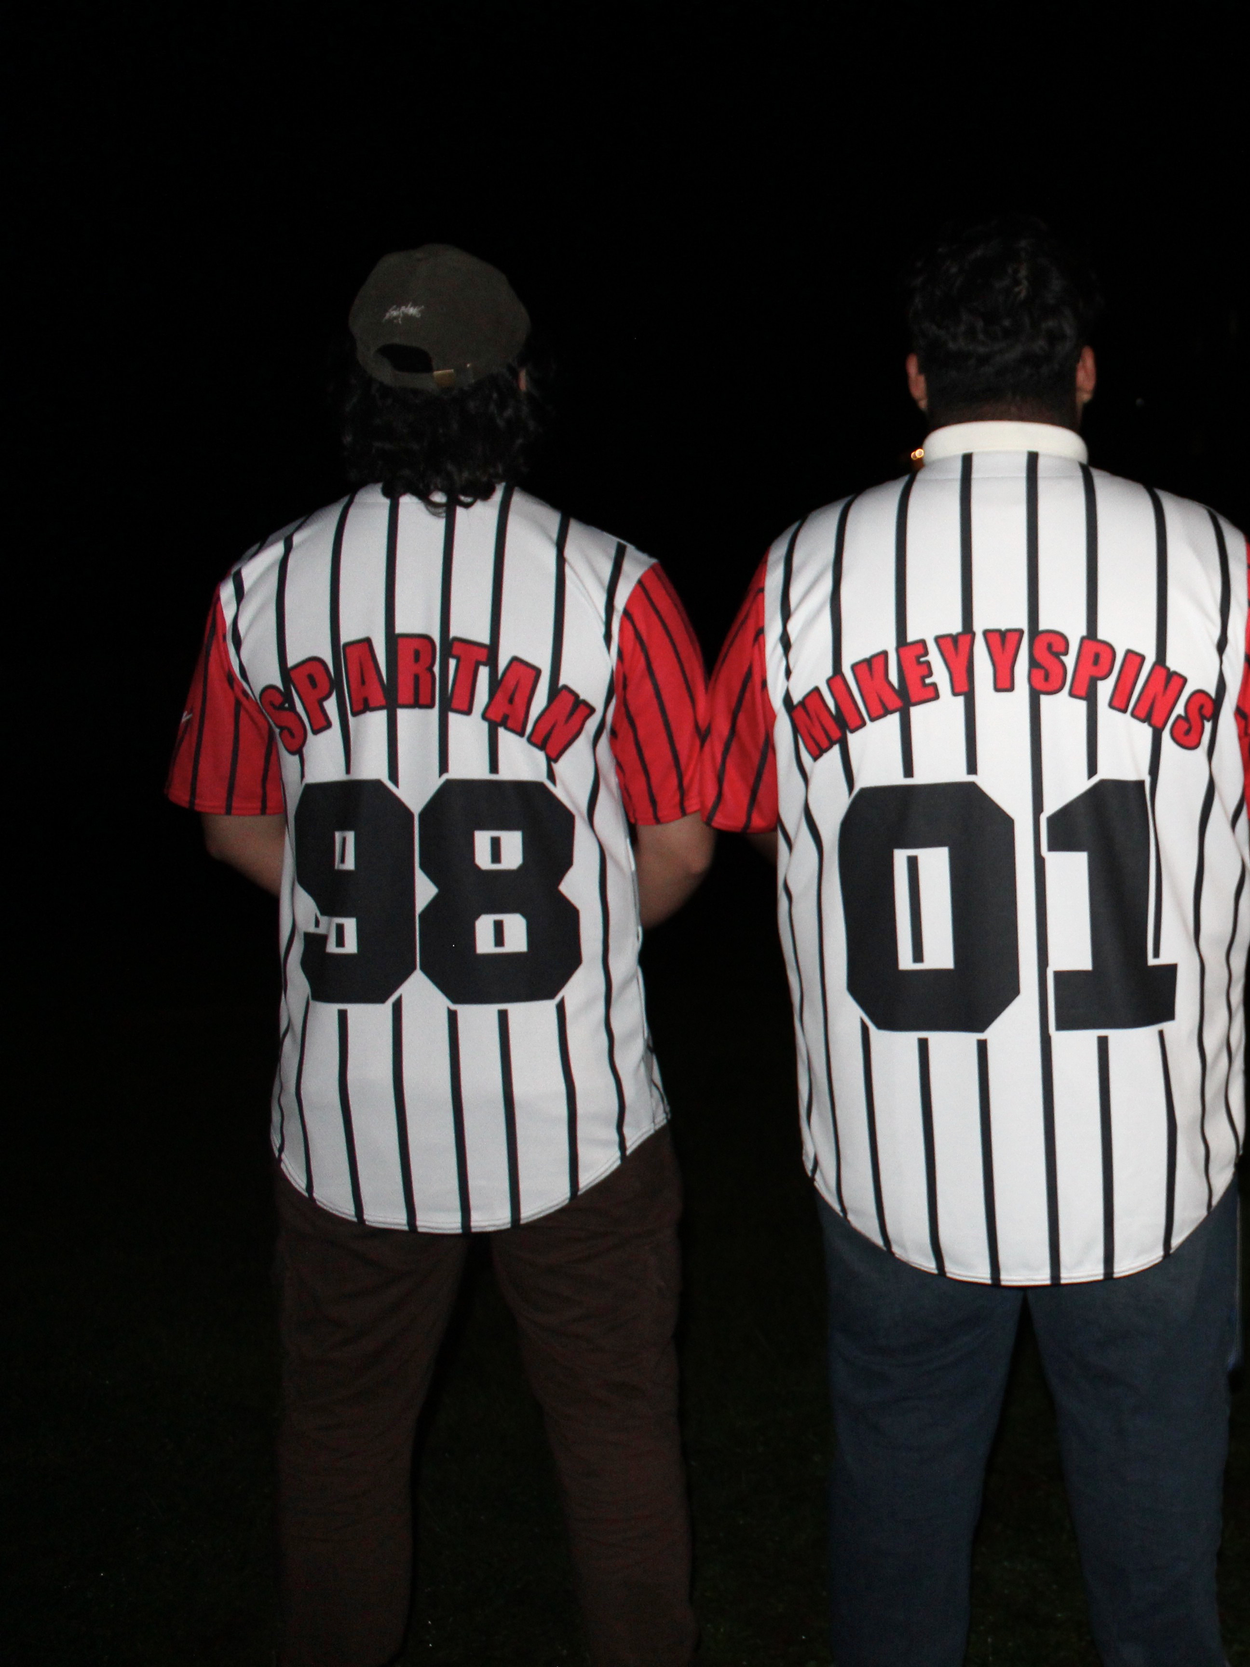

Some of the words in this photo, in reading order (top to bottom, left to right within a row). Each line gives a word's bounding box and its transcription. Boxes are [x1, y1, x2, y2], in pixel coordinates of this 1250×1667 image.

[258, 633, 596, 764] SPARTAN
[788, 628, 1216, 763] MIKEYYSPINS
[294, 778, 583, 1005] 98
[838, 780, 1178, 1034] 01
